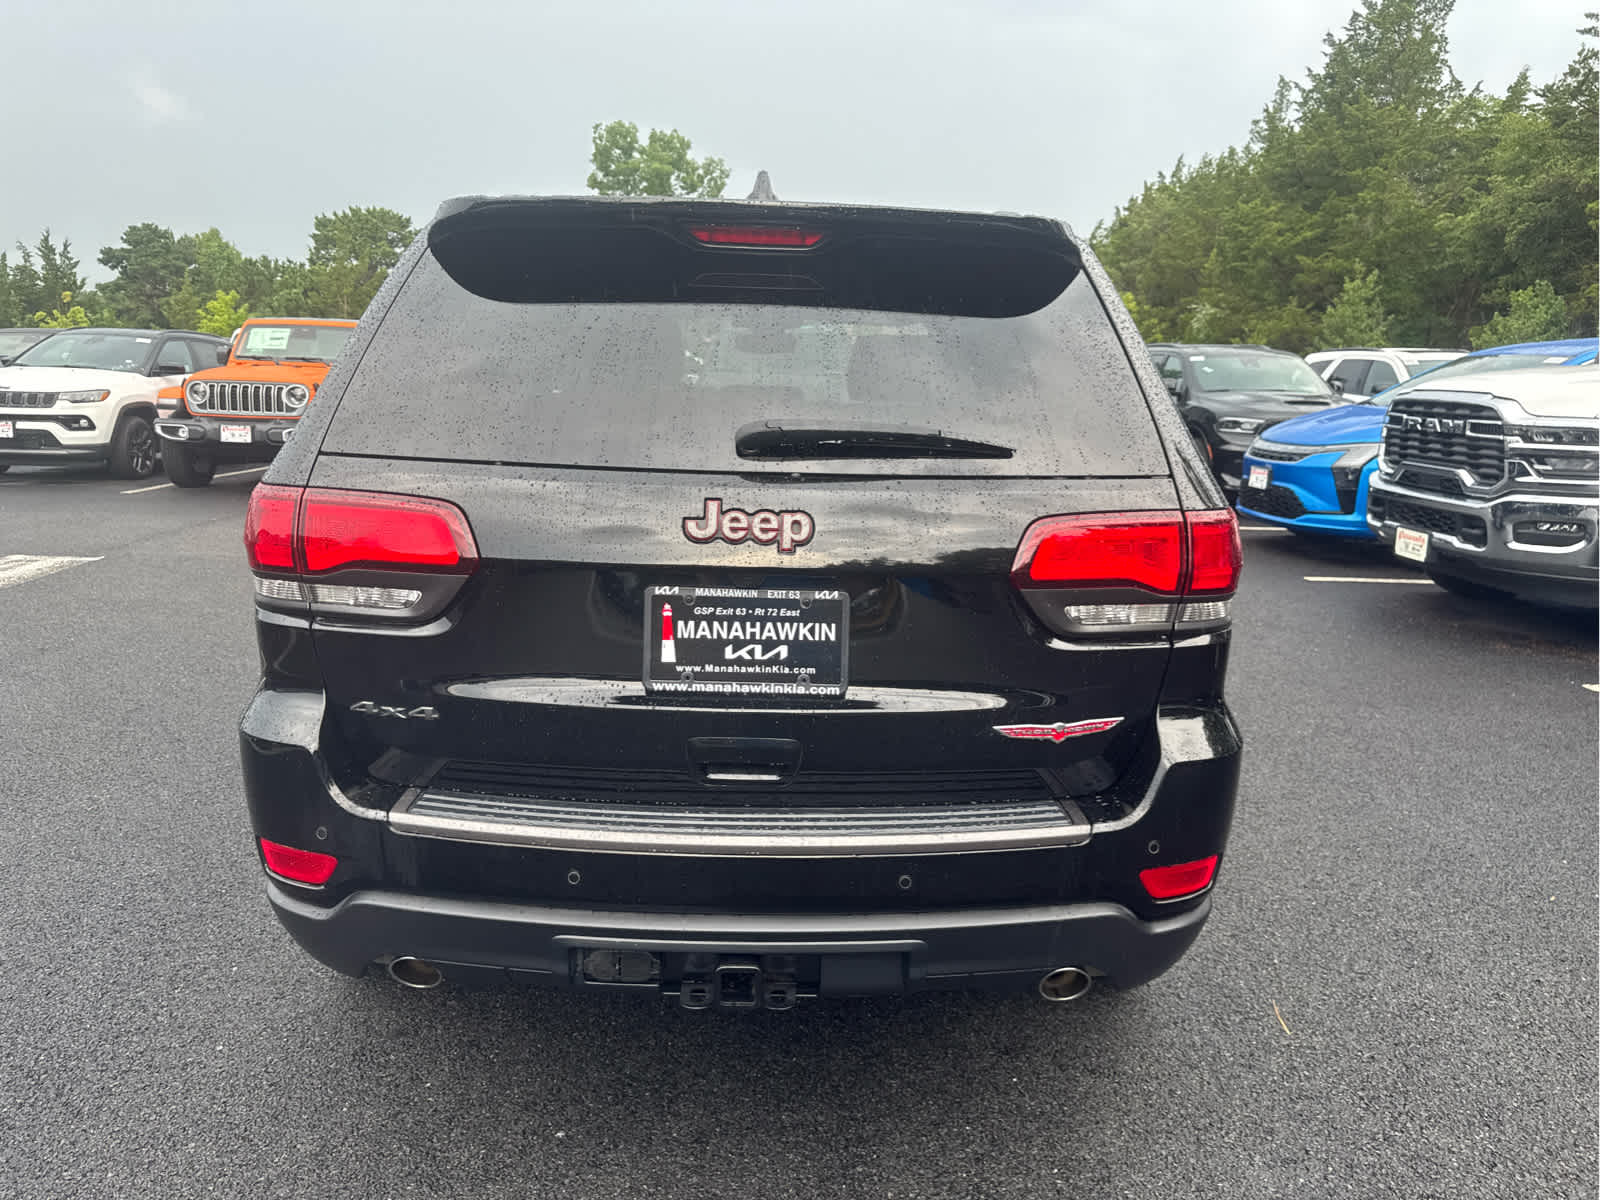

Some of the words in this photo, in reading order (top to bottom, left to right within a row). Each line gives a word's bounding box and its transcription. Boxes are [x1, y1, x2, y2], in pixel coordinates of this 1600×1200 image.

[1402, 414, 1465, 434] RAM
[683, 498, 815, 554] Jeep
[695, 588, 759, 598] MANAHAWKIN
[767, 590, 787, 599] EXIT
[788, 590, 801, 599] 63
[693, 606, 714, 615] GSP
[715, 607, 734, 616] Exit
[735, 607, 747, 616] 63
[753, 607, 765, 616] Rt
[767, 608, 778, 616] 72
[779, 608, 800, 617] East
[677, 620, 836, 641] MANAHAWKIN
[675, 664, 816, 675] www.ManahawkinKia.com
[652, 681, 840, 695] www.manahawkinkia.com
